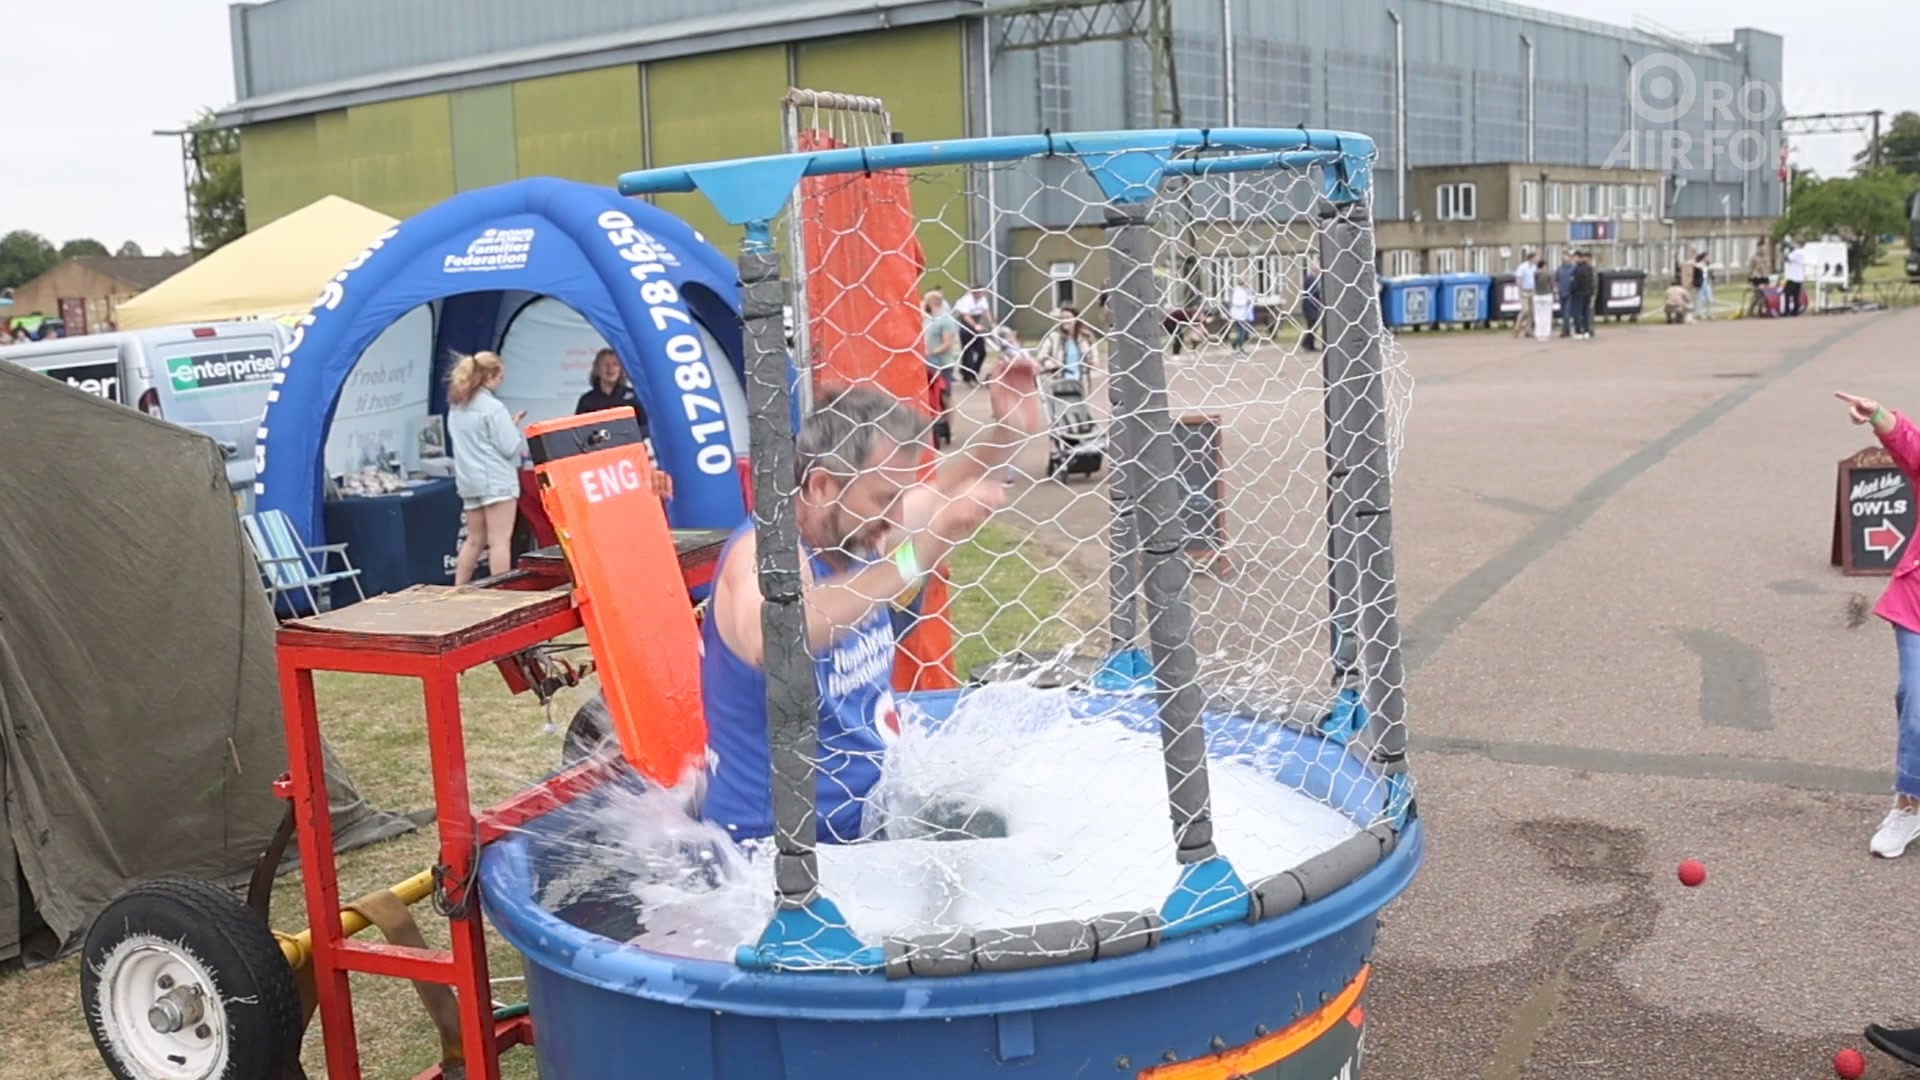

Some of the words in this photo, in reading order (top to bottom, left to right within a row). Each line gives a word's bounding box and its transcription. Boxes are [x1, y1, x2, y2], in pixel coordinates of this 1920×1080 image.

[444, 252, 528, 267] Federation
[467, 243, 530, 255] Families
[598, 210, 691, 331] 781650
[175, 353, 275, 382] enterprise
[666, 334, 732, 475] 01780
[581, 459, 640, 503] ENG
[1850, 478, 1879, 500] Meet
[1880, 473, 1901, 490] the
[1852, 500, 1907, 516] OWLS
